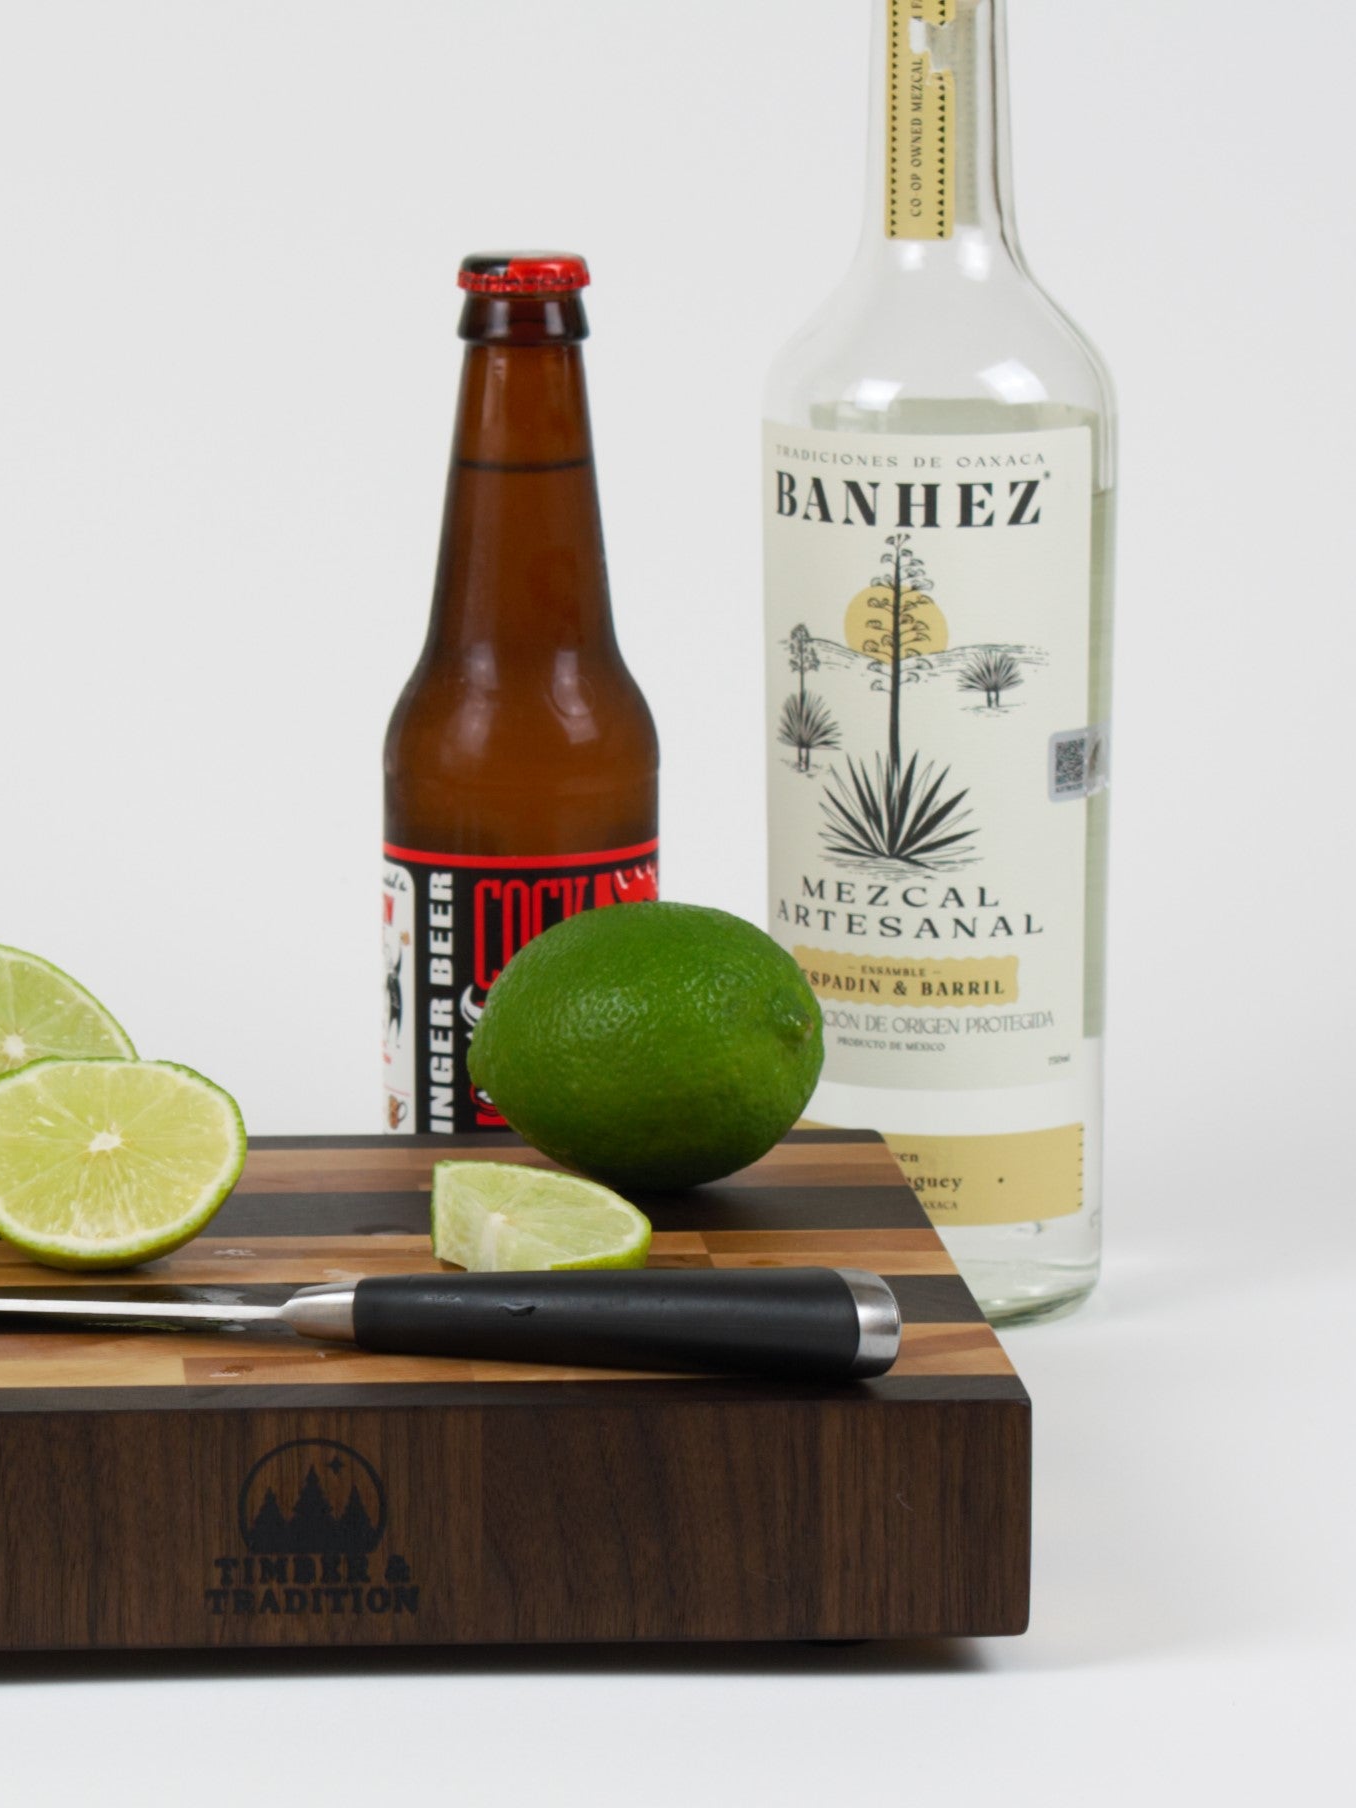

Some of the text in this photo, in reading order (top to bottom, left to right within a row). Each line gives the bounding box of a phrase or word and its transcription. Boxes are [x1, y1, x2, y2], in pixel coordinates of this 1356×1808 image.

[910, 58, 924, 114] MEZCAL
[909, 117, 923, 168] OWNED
[776, 444, 1046, 468] TRADICIONES DE OAXACA
[776, 470, 1041, 528] BANHEZ
[801, 875, 1000, 909] MEZCAL
[776, 899, 1044, 939] ARTESANAL
[860, 965, 927, 977] ENSAMBLE
[428, 872, 453, 1134] INGER BEER
[892, 980, 908, 996] &
[921, 980, 1005, 996] BARRIL
[865, 1014, 888, 1033] DE
[891, 1016, 961, 1035] ORIGEN
[965, 1010, 1055, 1035] PROTEGIDA
[889, 1040, 902, 1051] DE
[906, 1176, 963, 1192] guey
[214, 1554, 411, 1585] TIMBER &
[204, 1586, 420, 1615] TRADITION
